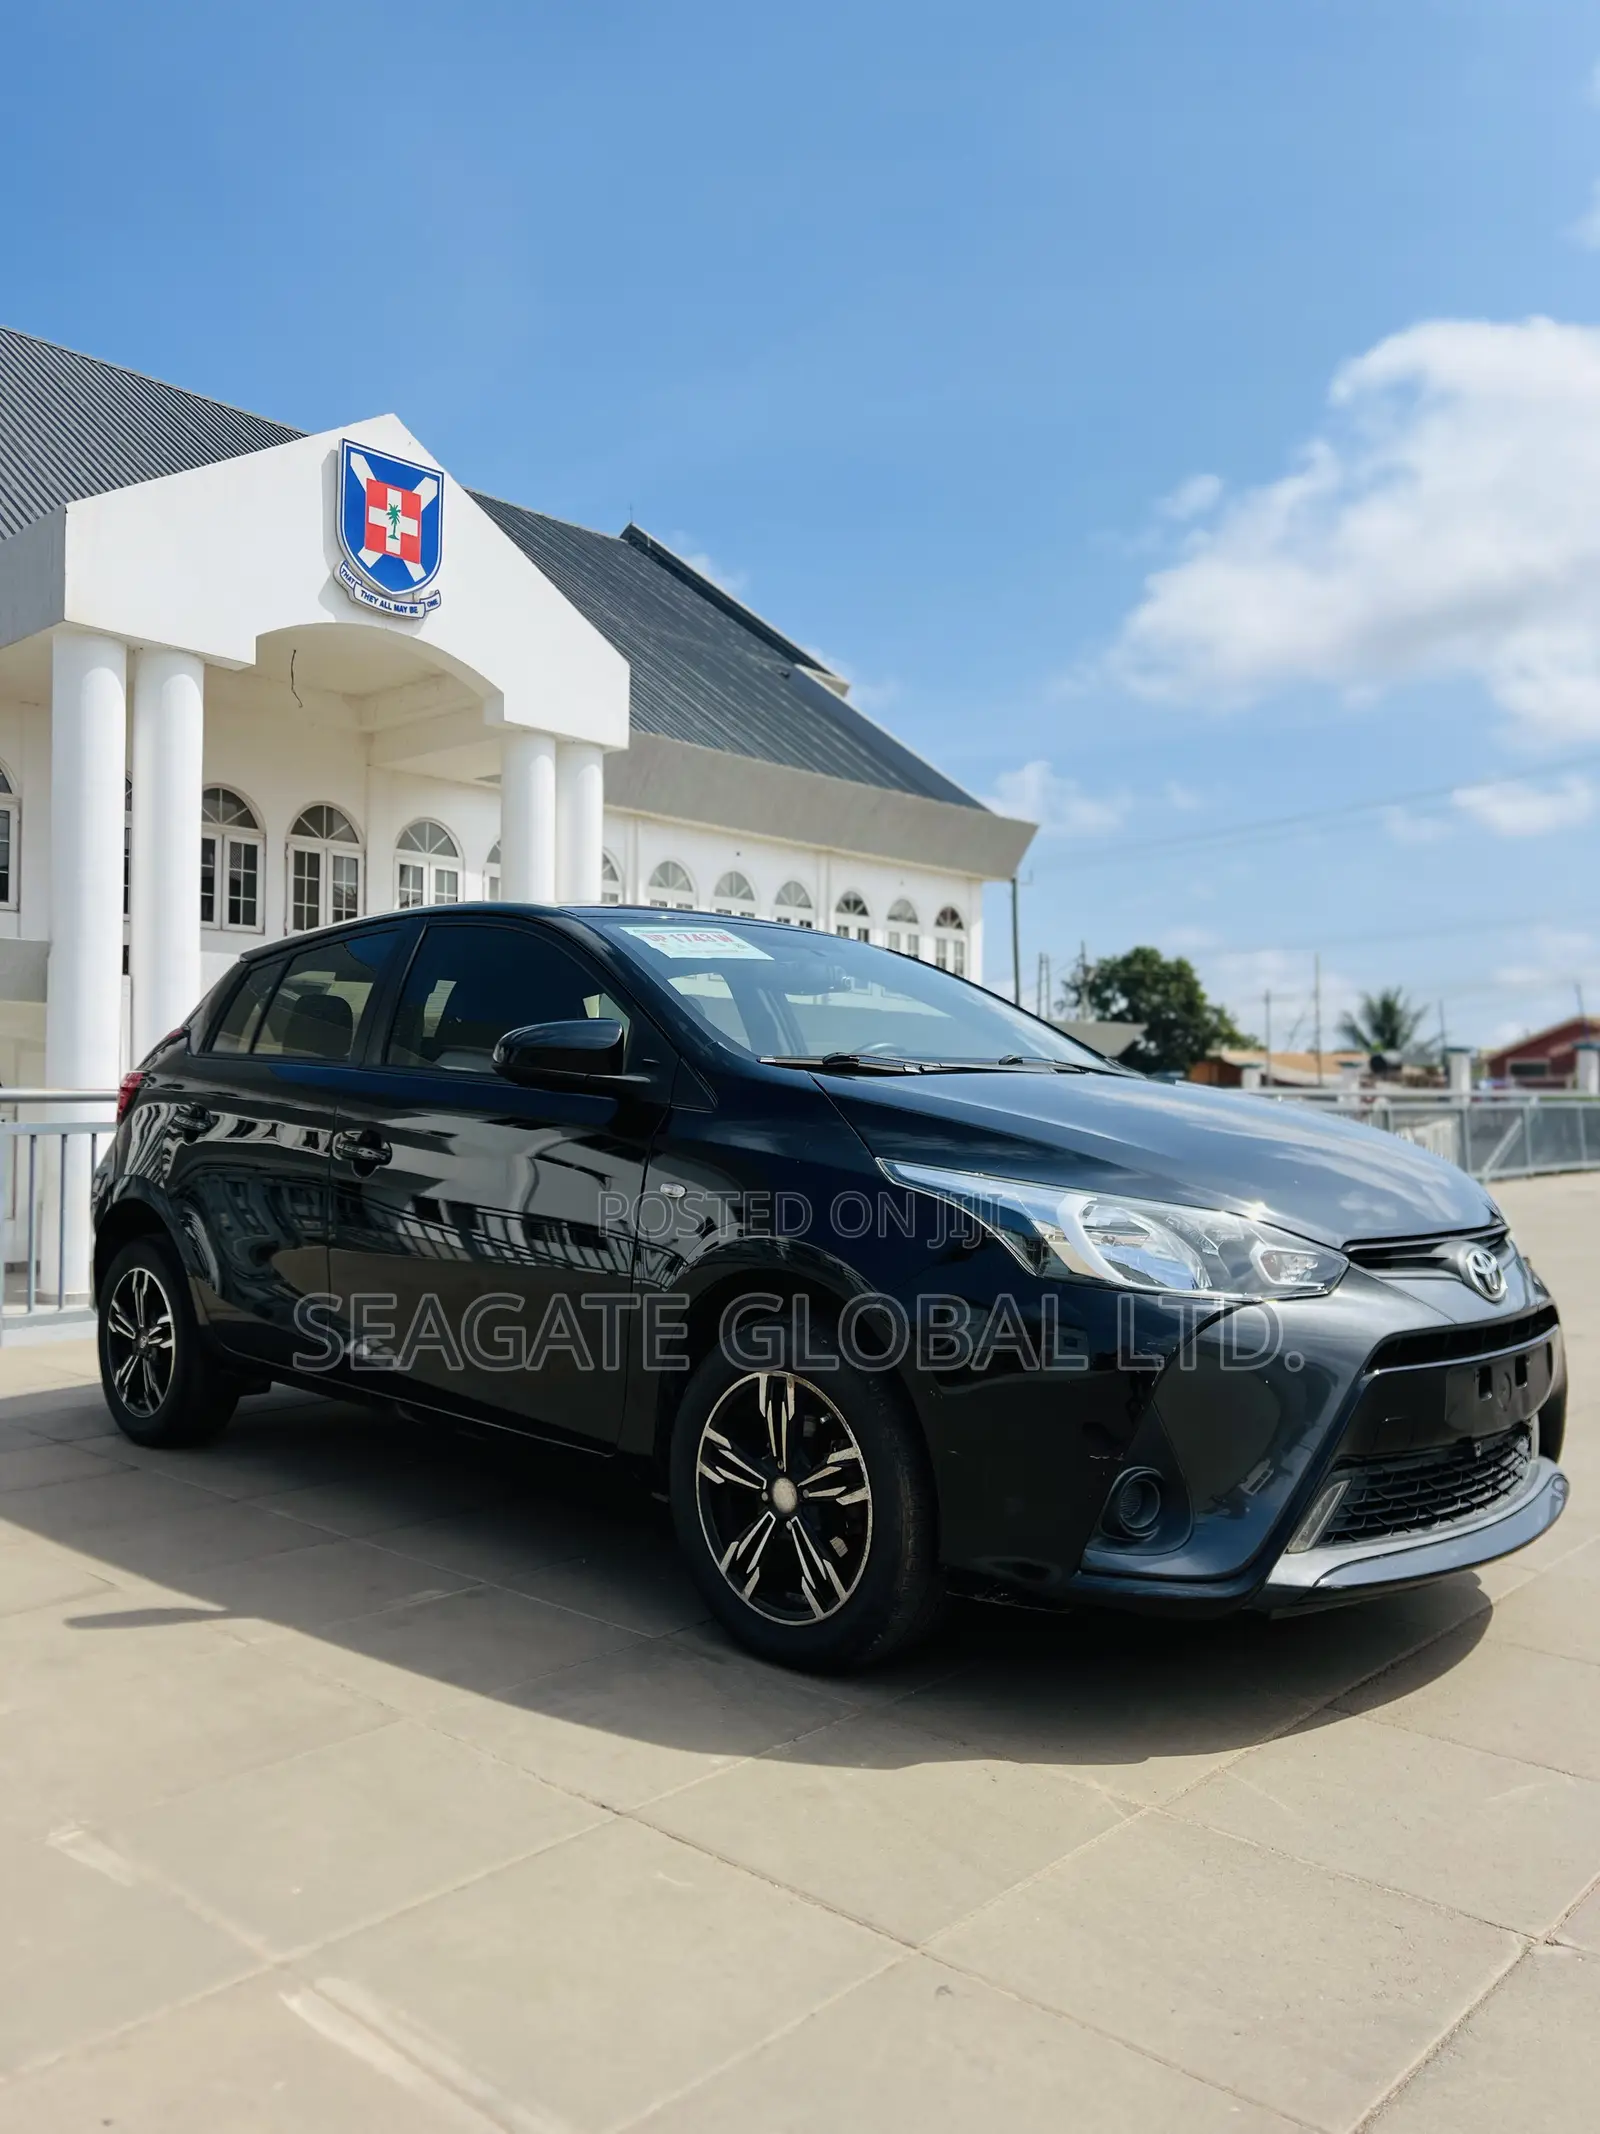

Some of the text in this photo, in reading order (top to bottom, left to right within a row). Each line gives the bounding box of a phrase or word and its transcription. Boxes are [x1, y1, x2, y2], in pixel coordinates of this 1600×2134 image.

[341, 568, 439, 614] THAT THEY ALL MAY BE ONE
[669, 933, 716, 943] 1743
